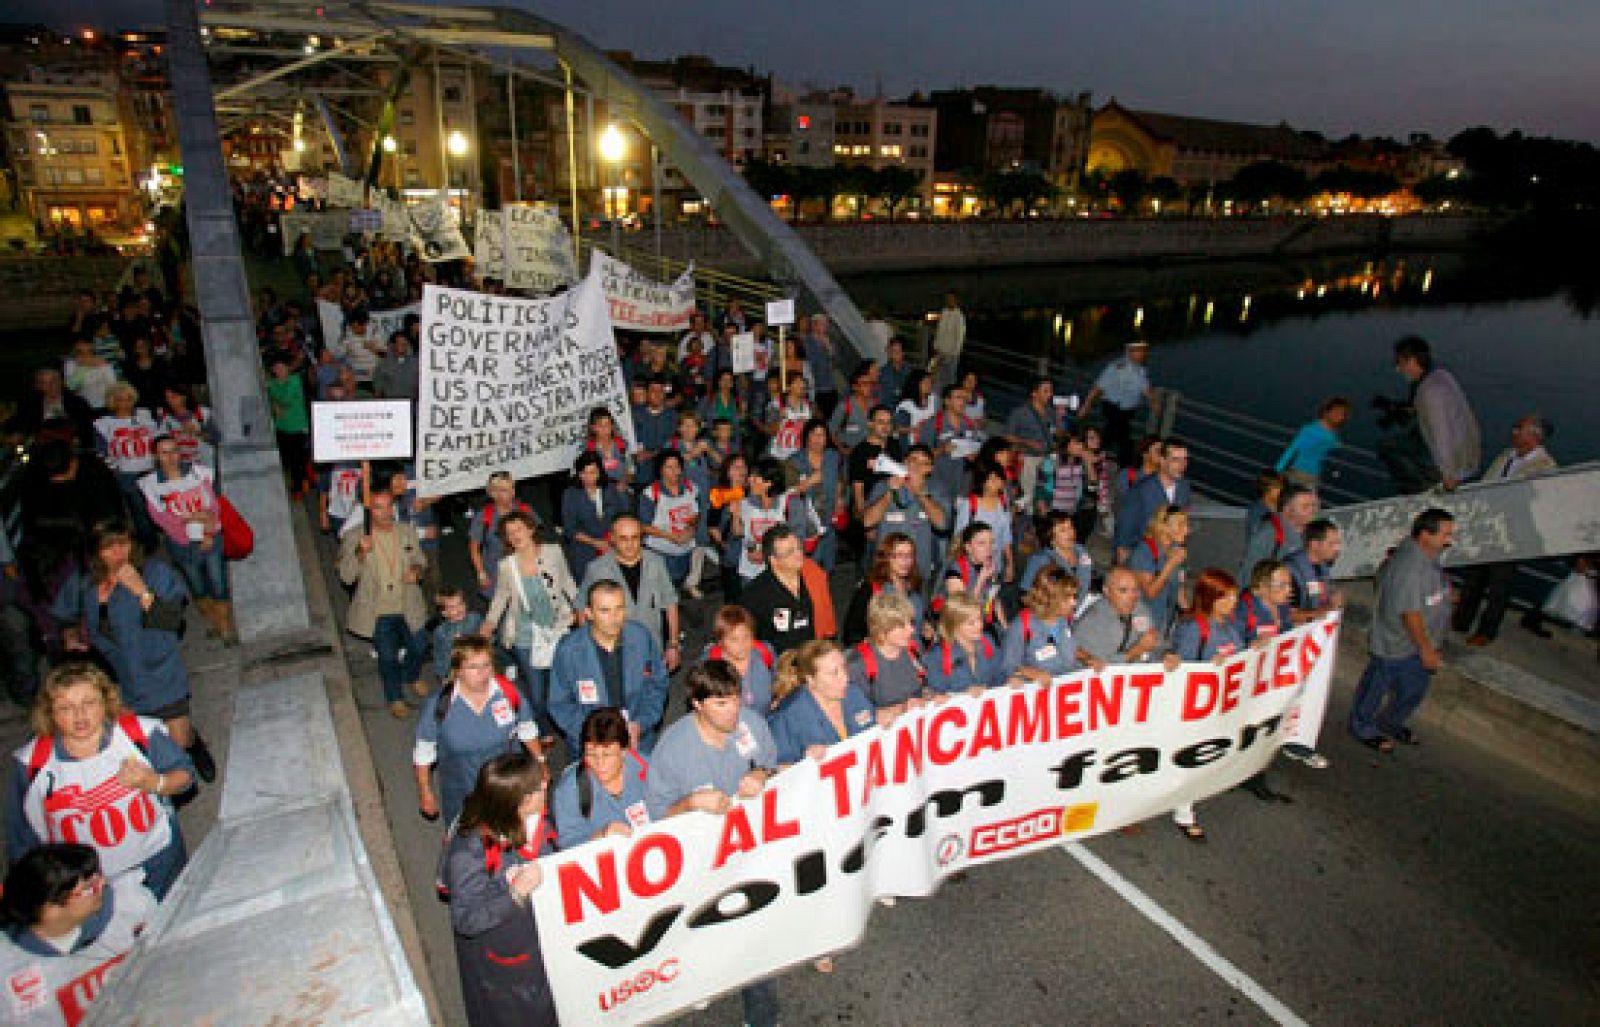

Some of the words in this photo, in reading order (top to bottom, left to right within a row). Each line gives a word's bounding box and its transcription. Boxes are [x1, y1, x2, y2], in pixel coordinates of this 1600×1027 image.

[430, 348, 499, 378] LEAR
[432, 378, 468, 402] US
[430, 403, 464, 430] DE
[470, 403, 499, 429] LA
[499, 386, 577, 423] VOSTRA
[423, 458, 452, 480] ES
[557, 831, 684, 926] NO
[712, 797, 800, 870] AL
[818, 671, 1165, 818] TANCAMENT
[1180, 660, 1246, 722] DE
